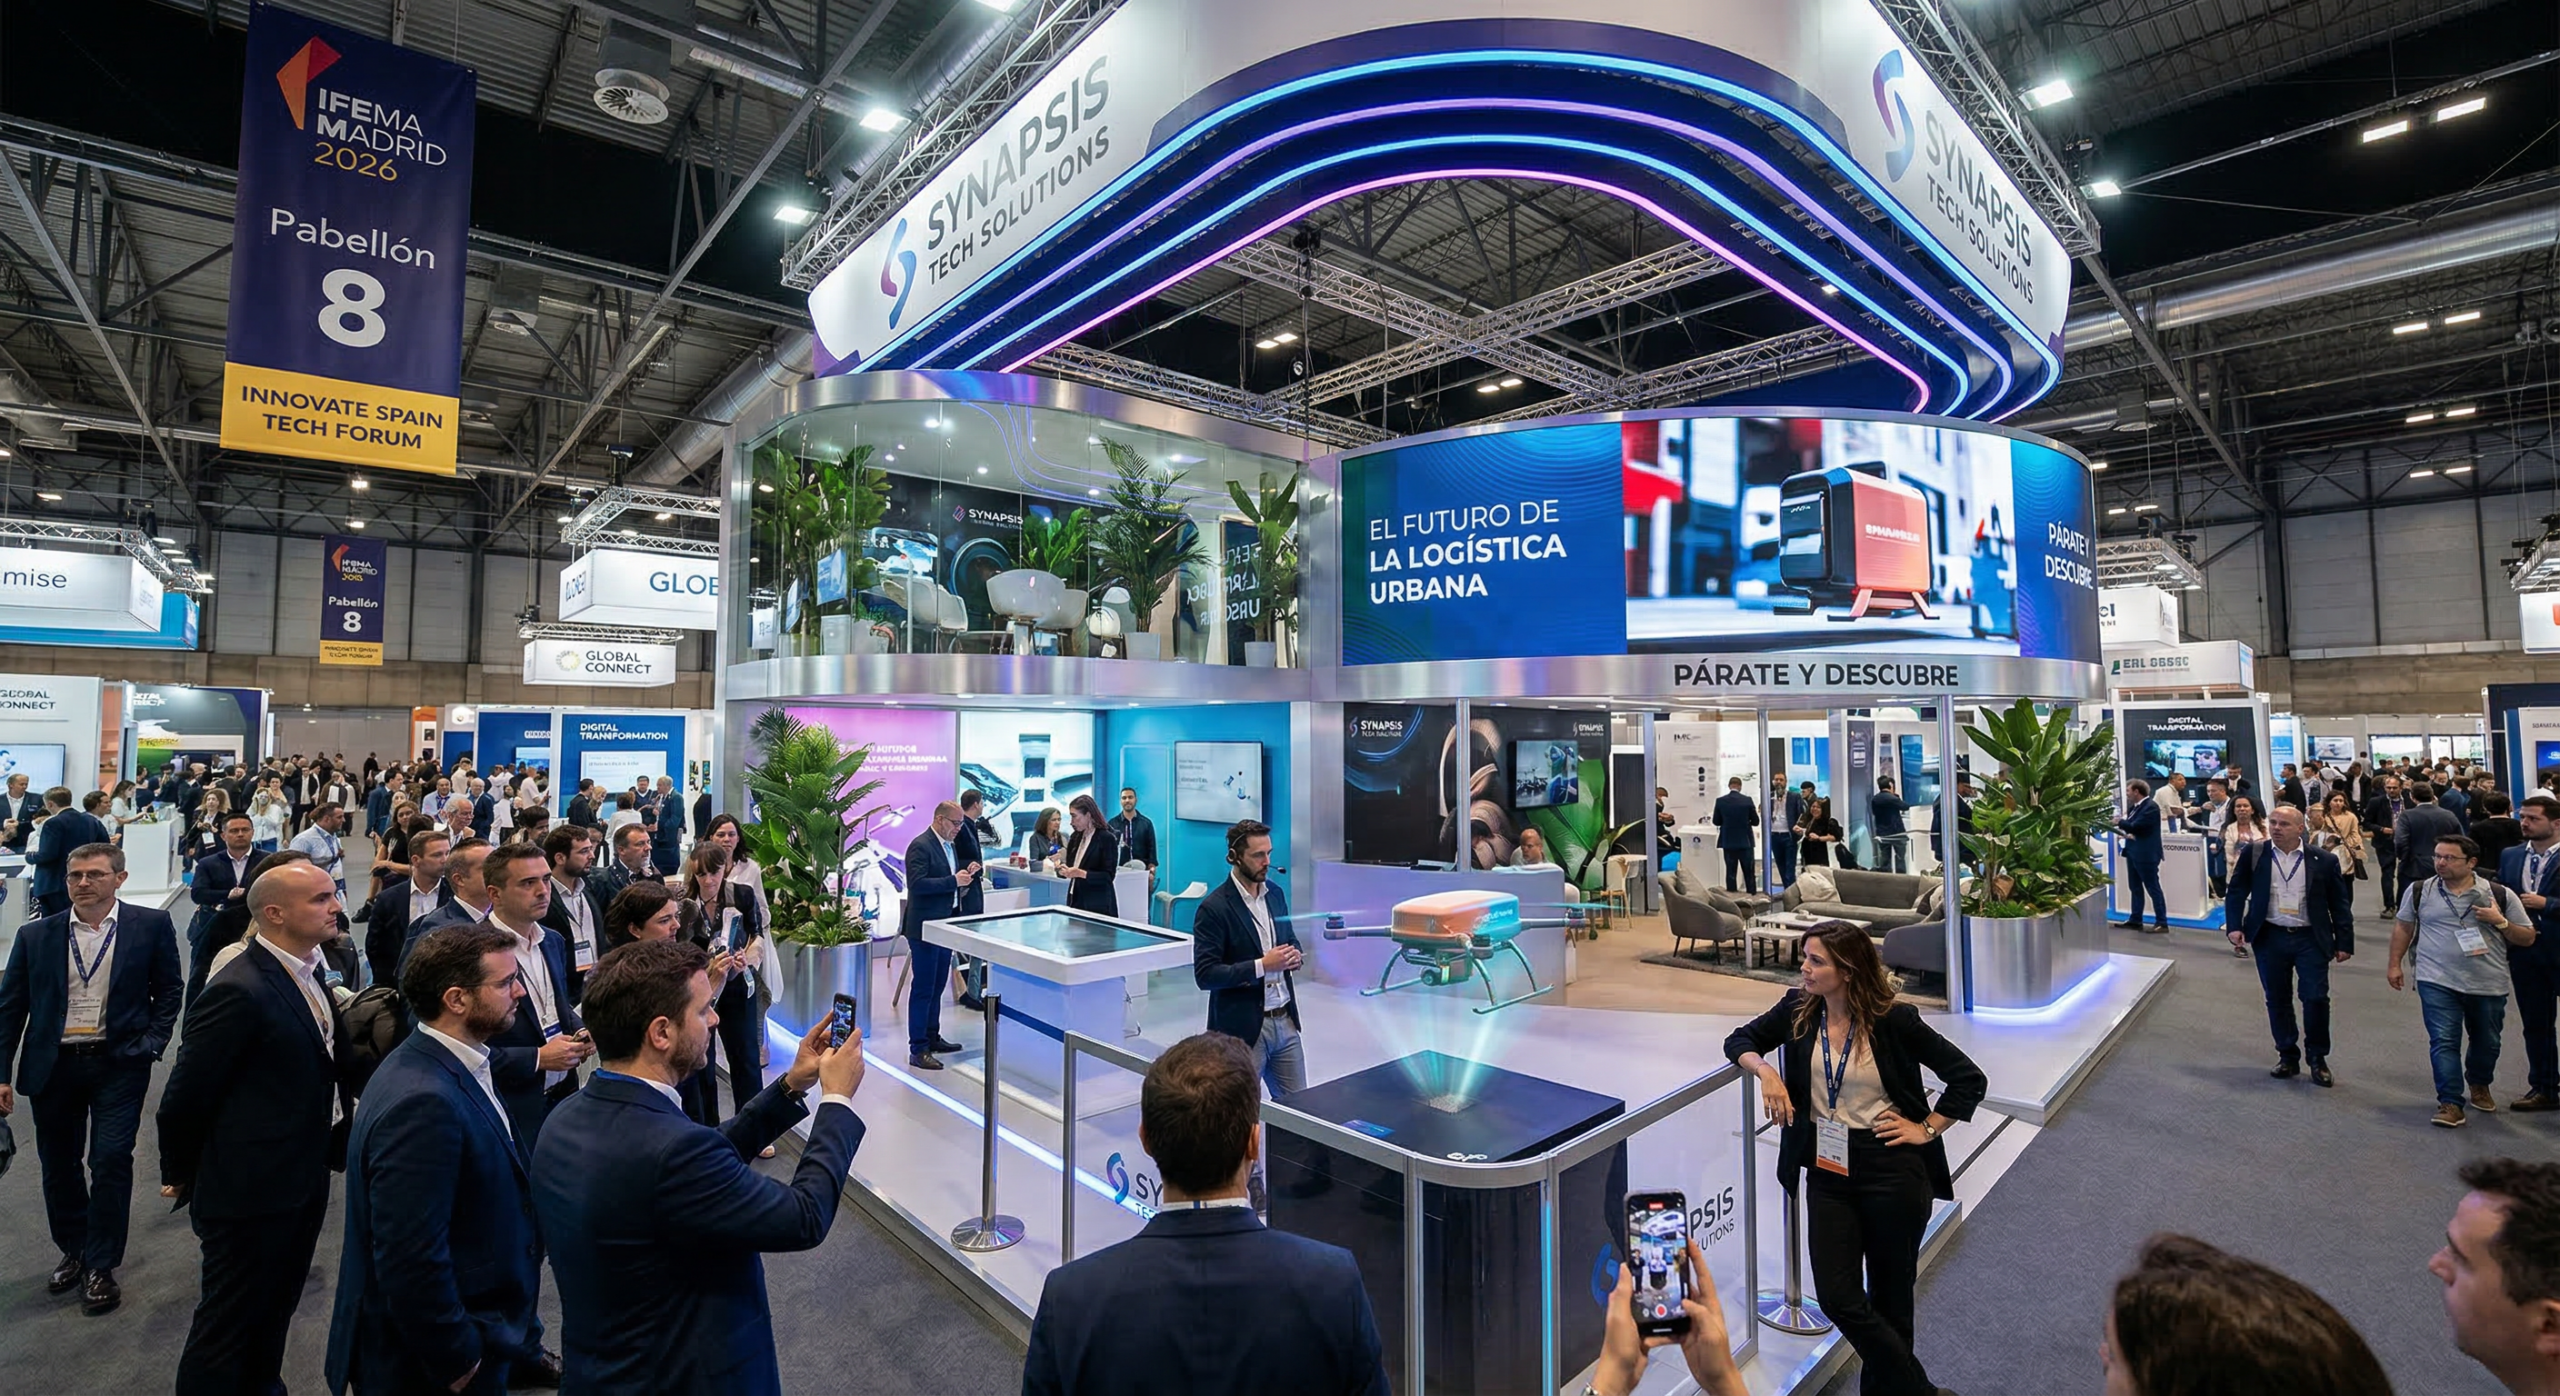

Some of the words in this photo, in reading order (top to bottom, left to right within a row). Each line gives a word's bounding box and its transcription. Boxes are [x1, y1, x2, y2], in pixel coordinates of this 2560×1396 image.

[319, 87, 423, 137] IFEMA
[317, 113, 447, 166] MADRID
[928, 55, 1110, 250] SYNAPSIS
[314, 141, 398, 182] 2026
[928, 232, 974, 285] TECH
[981, 125, 1110, 247] SOLUTIONS
[1925, 110, 2031, 267] SYNAPSIS
[271, 207, 435, 269] Pabellón
[1927, 172, 1965, 232] TECH
[1969, 218, 2034, 305] SOLUTIONS
[317, 268, 387, 348] 8
[241, 385, 369, 418] INNOVATE
[375, 405, 443, 429] SPAIN
[262, 413, 327, 436] TECH
[335, 423, 422, 449] FORUM
[968, 508, 1024, 525] SYNAPSIS
[1370, 518, 1397, 541] EL
[1404, 504, 1511, 537] FUTURO
[1520, 499, 1560, 525] DE
[1370, 548, 1402, 573] LA
[1408, 533, 1567, 569] LOGÍSTICA
[2048, 520, 2085, 556] PÁRATE
[3, 569, 67, 589] mise
[1370, 573, 1489, 605] URBANA
[328, 596, 379, 608] Pabellón
[343, 611, 362, 633] 8
[585, 650, 641, 663] GLOBAL
[585, 662, 652, 674] CONNECT
[1673, 658, 1790, 686] PÁRATE
[1797, 663, 1817, 686] Y
[1825, 663, 1959, 687] DESCUBRE
[0, 700, 57, 710] ONNECT
[580, 723, 618, 732] DIGITAL
[1360, 720, 1403, 730] SYNAPSIS
[1135, 1172, 1164, 1207] SY
[1689, 1186, 1734, 1239] PSIS
[1697, 1218, 1735, 1251] UTIONS
